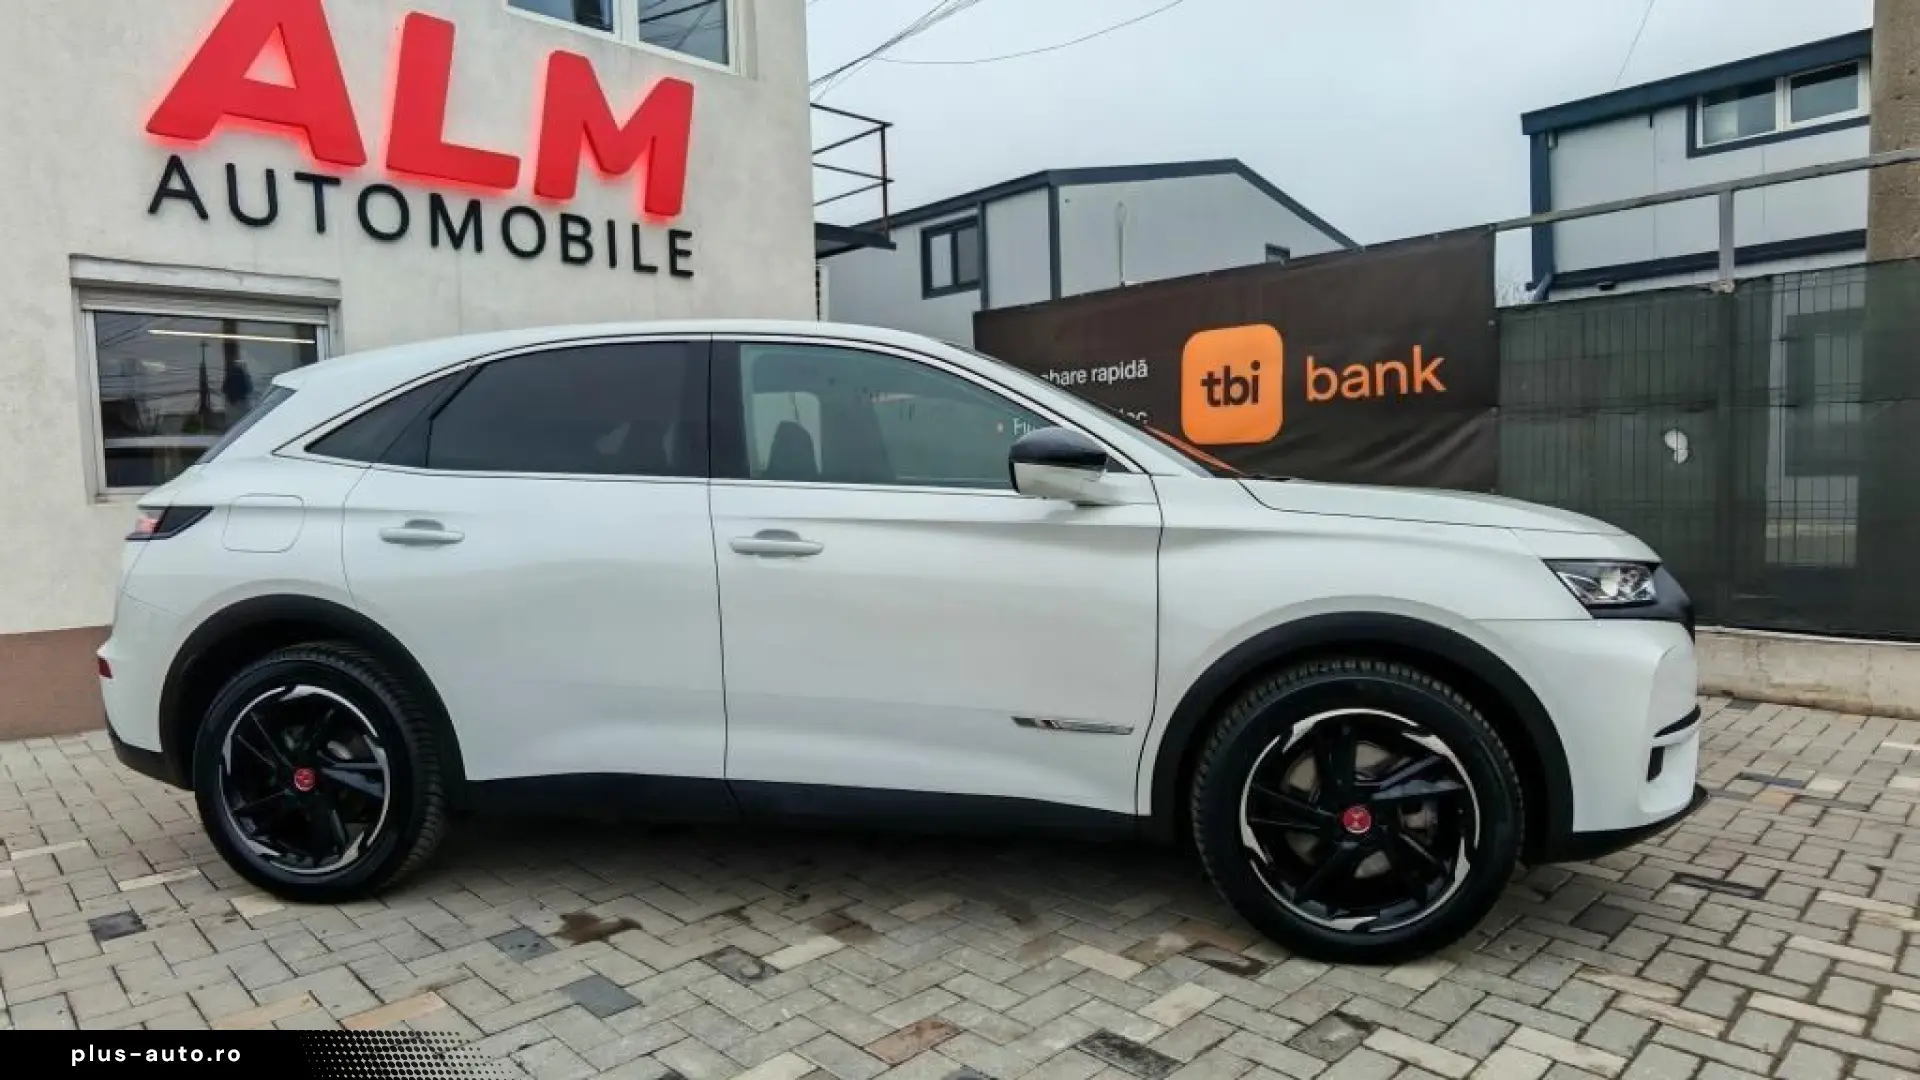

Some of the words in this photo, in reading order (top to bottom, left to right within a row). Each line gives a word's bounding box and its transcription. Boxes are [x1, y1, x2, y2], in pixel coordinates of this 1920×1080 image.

[146, 0, 694, 217] ALM
[147, 154, 694, 278] AUTOMOBILE
[1091, 359, 1148, 384] rapidă
[1201, 360, 1260, 407] tbi
[1307, 345, 1447, 400] bank
